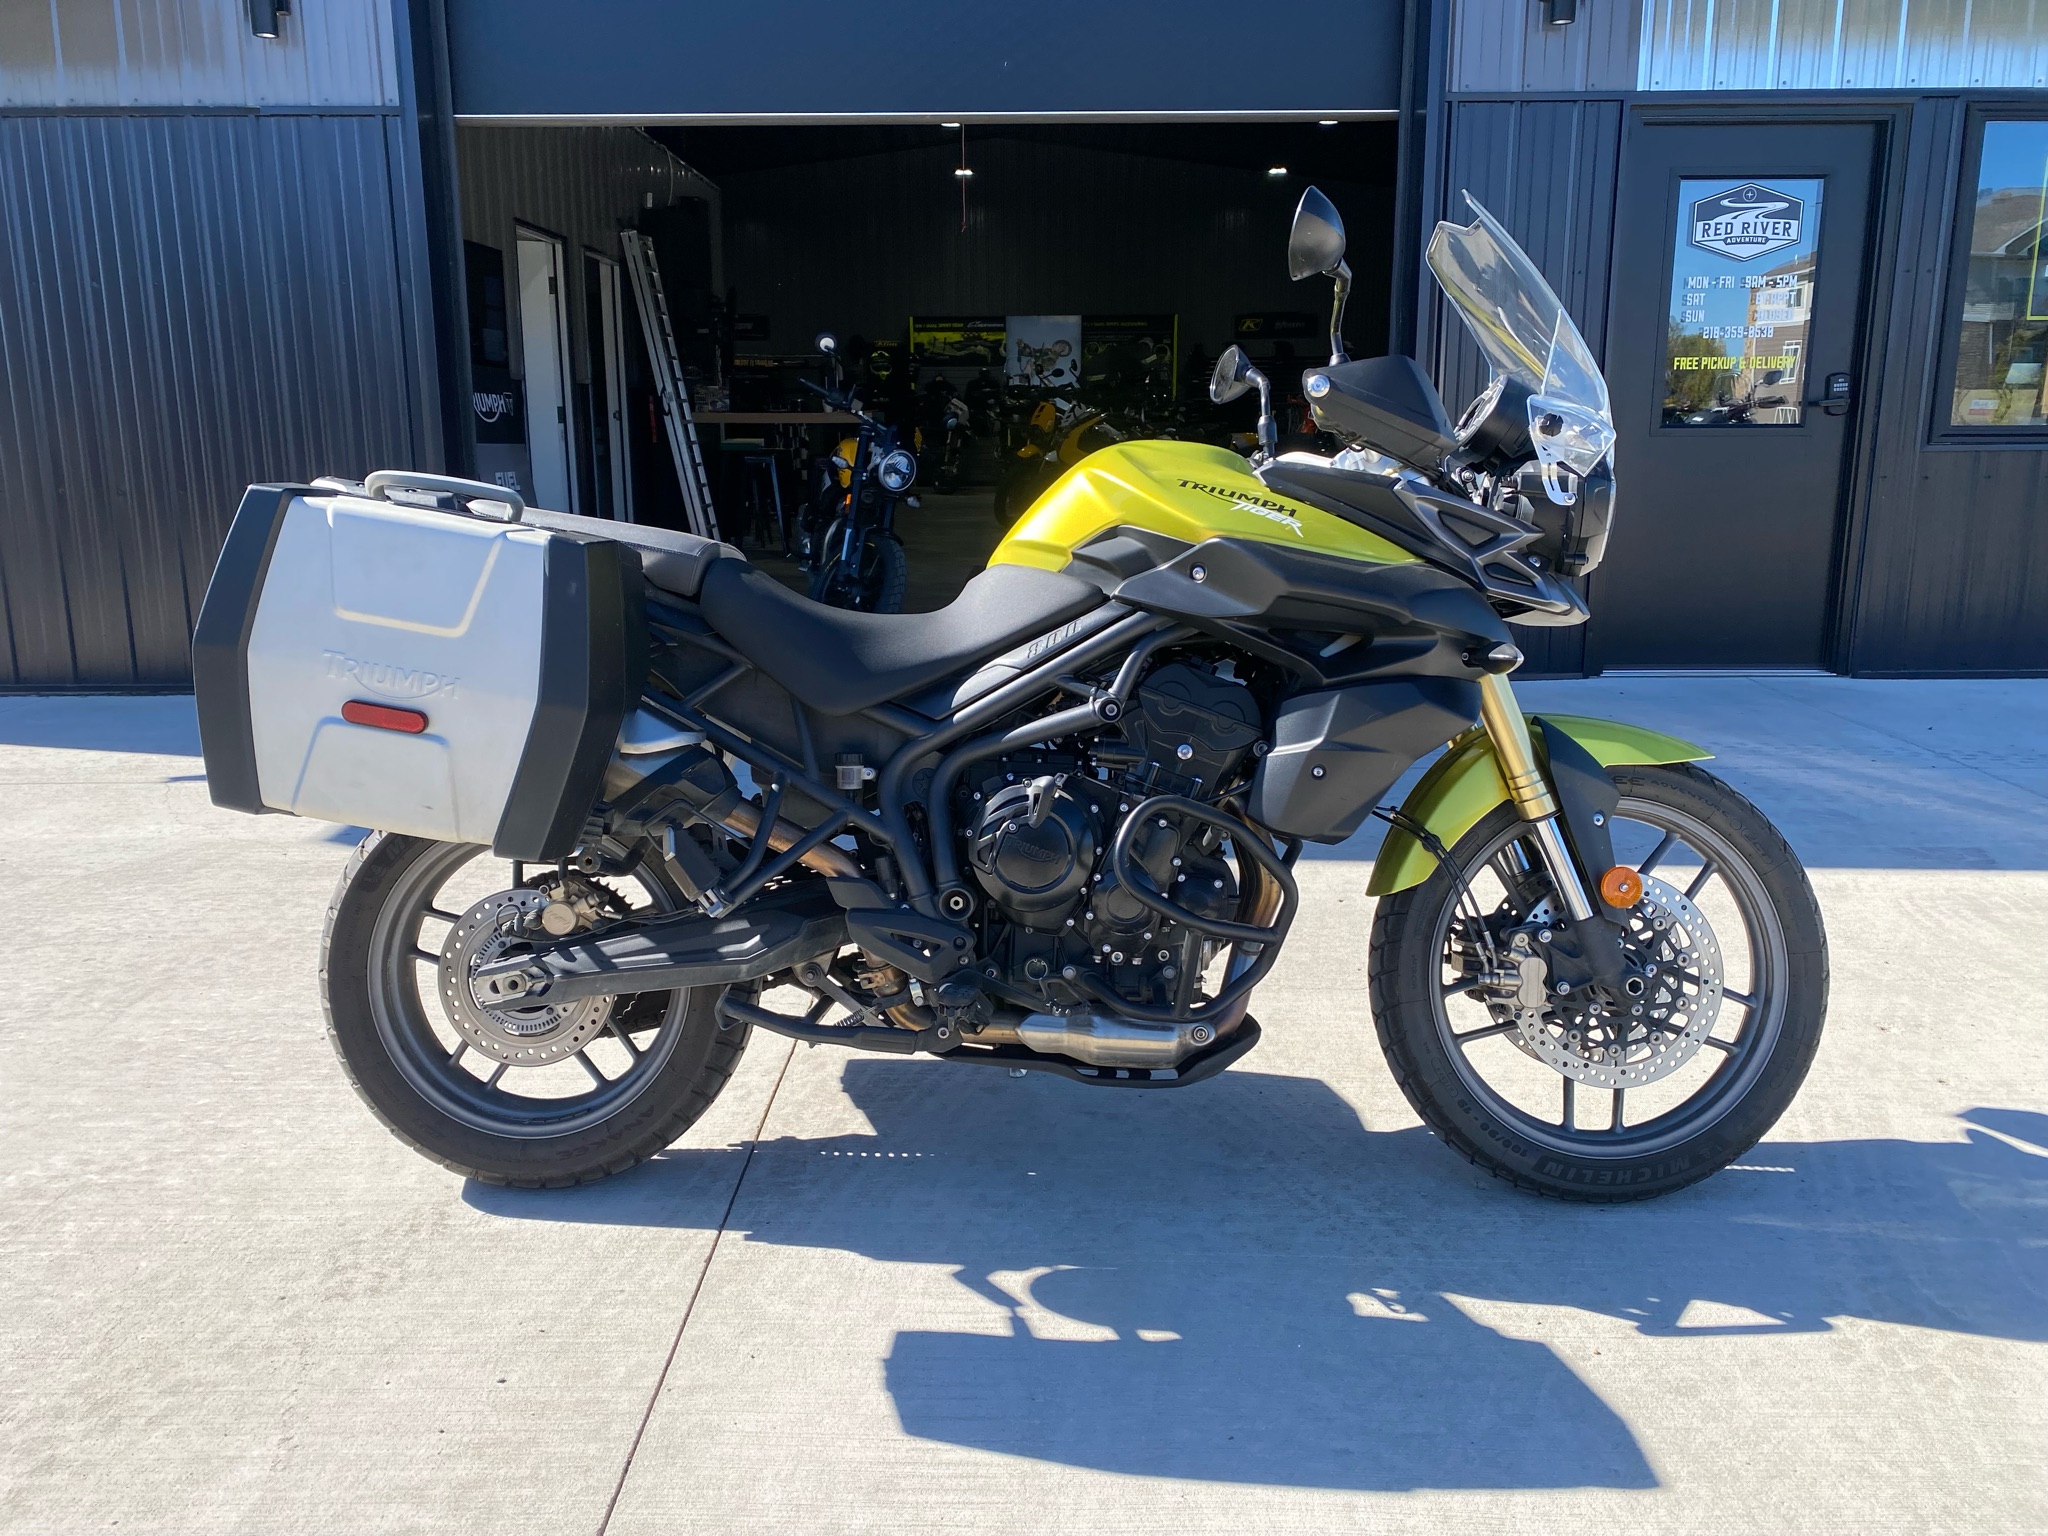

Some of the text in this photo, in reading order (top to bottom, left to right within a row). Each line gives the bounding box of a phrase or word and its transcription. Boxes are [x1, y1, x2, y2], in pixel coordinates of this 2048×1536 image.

[1701, 221, 1792, 238] RED RIVER
[1726, 236, 1767, 244] ADVENTURE
[1687, 276, 1710, 289] MON
[1719, 276, 1735, 289] FRI
[1745, 276, 1767, 289] 9AM
[1776, 275, 1798, 288] 5PM
[1686, 293, 1706, 306] SAT
[1685, 310, 1705, 322] SUN
[1674, 357, 1699, 370] FREE
[1701, 356, 1737, 370] PICKUP
[1749, 356, 1796, 369] DELIVERY
[473, 392, 507, 423] IUMPH
[1177, 478, 1297, 518] TRIUMPH
[1230, 499, 1304, 538] TIGER
[322, 648, 461, 700] TRIUMPH
[1004, 834, 1062, 865] TRIUMPH
[1543, 1153, 1691, 1185] MICHELIN
